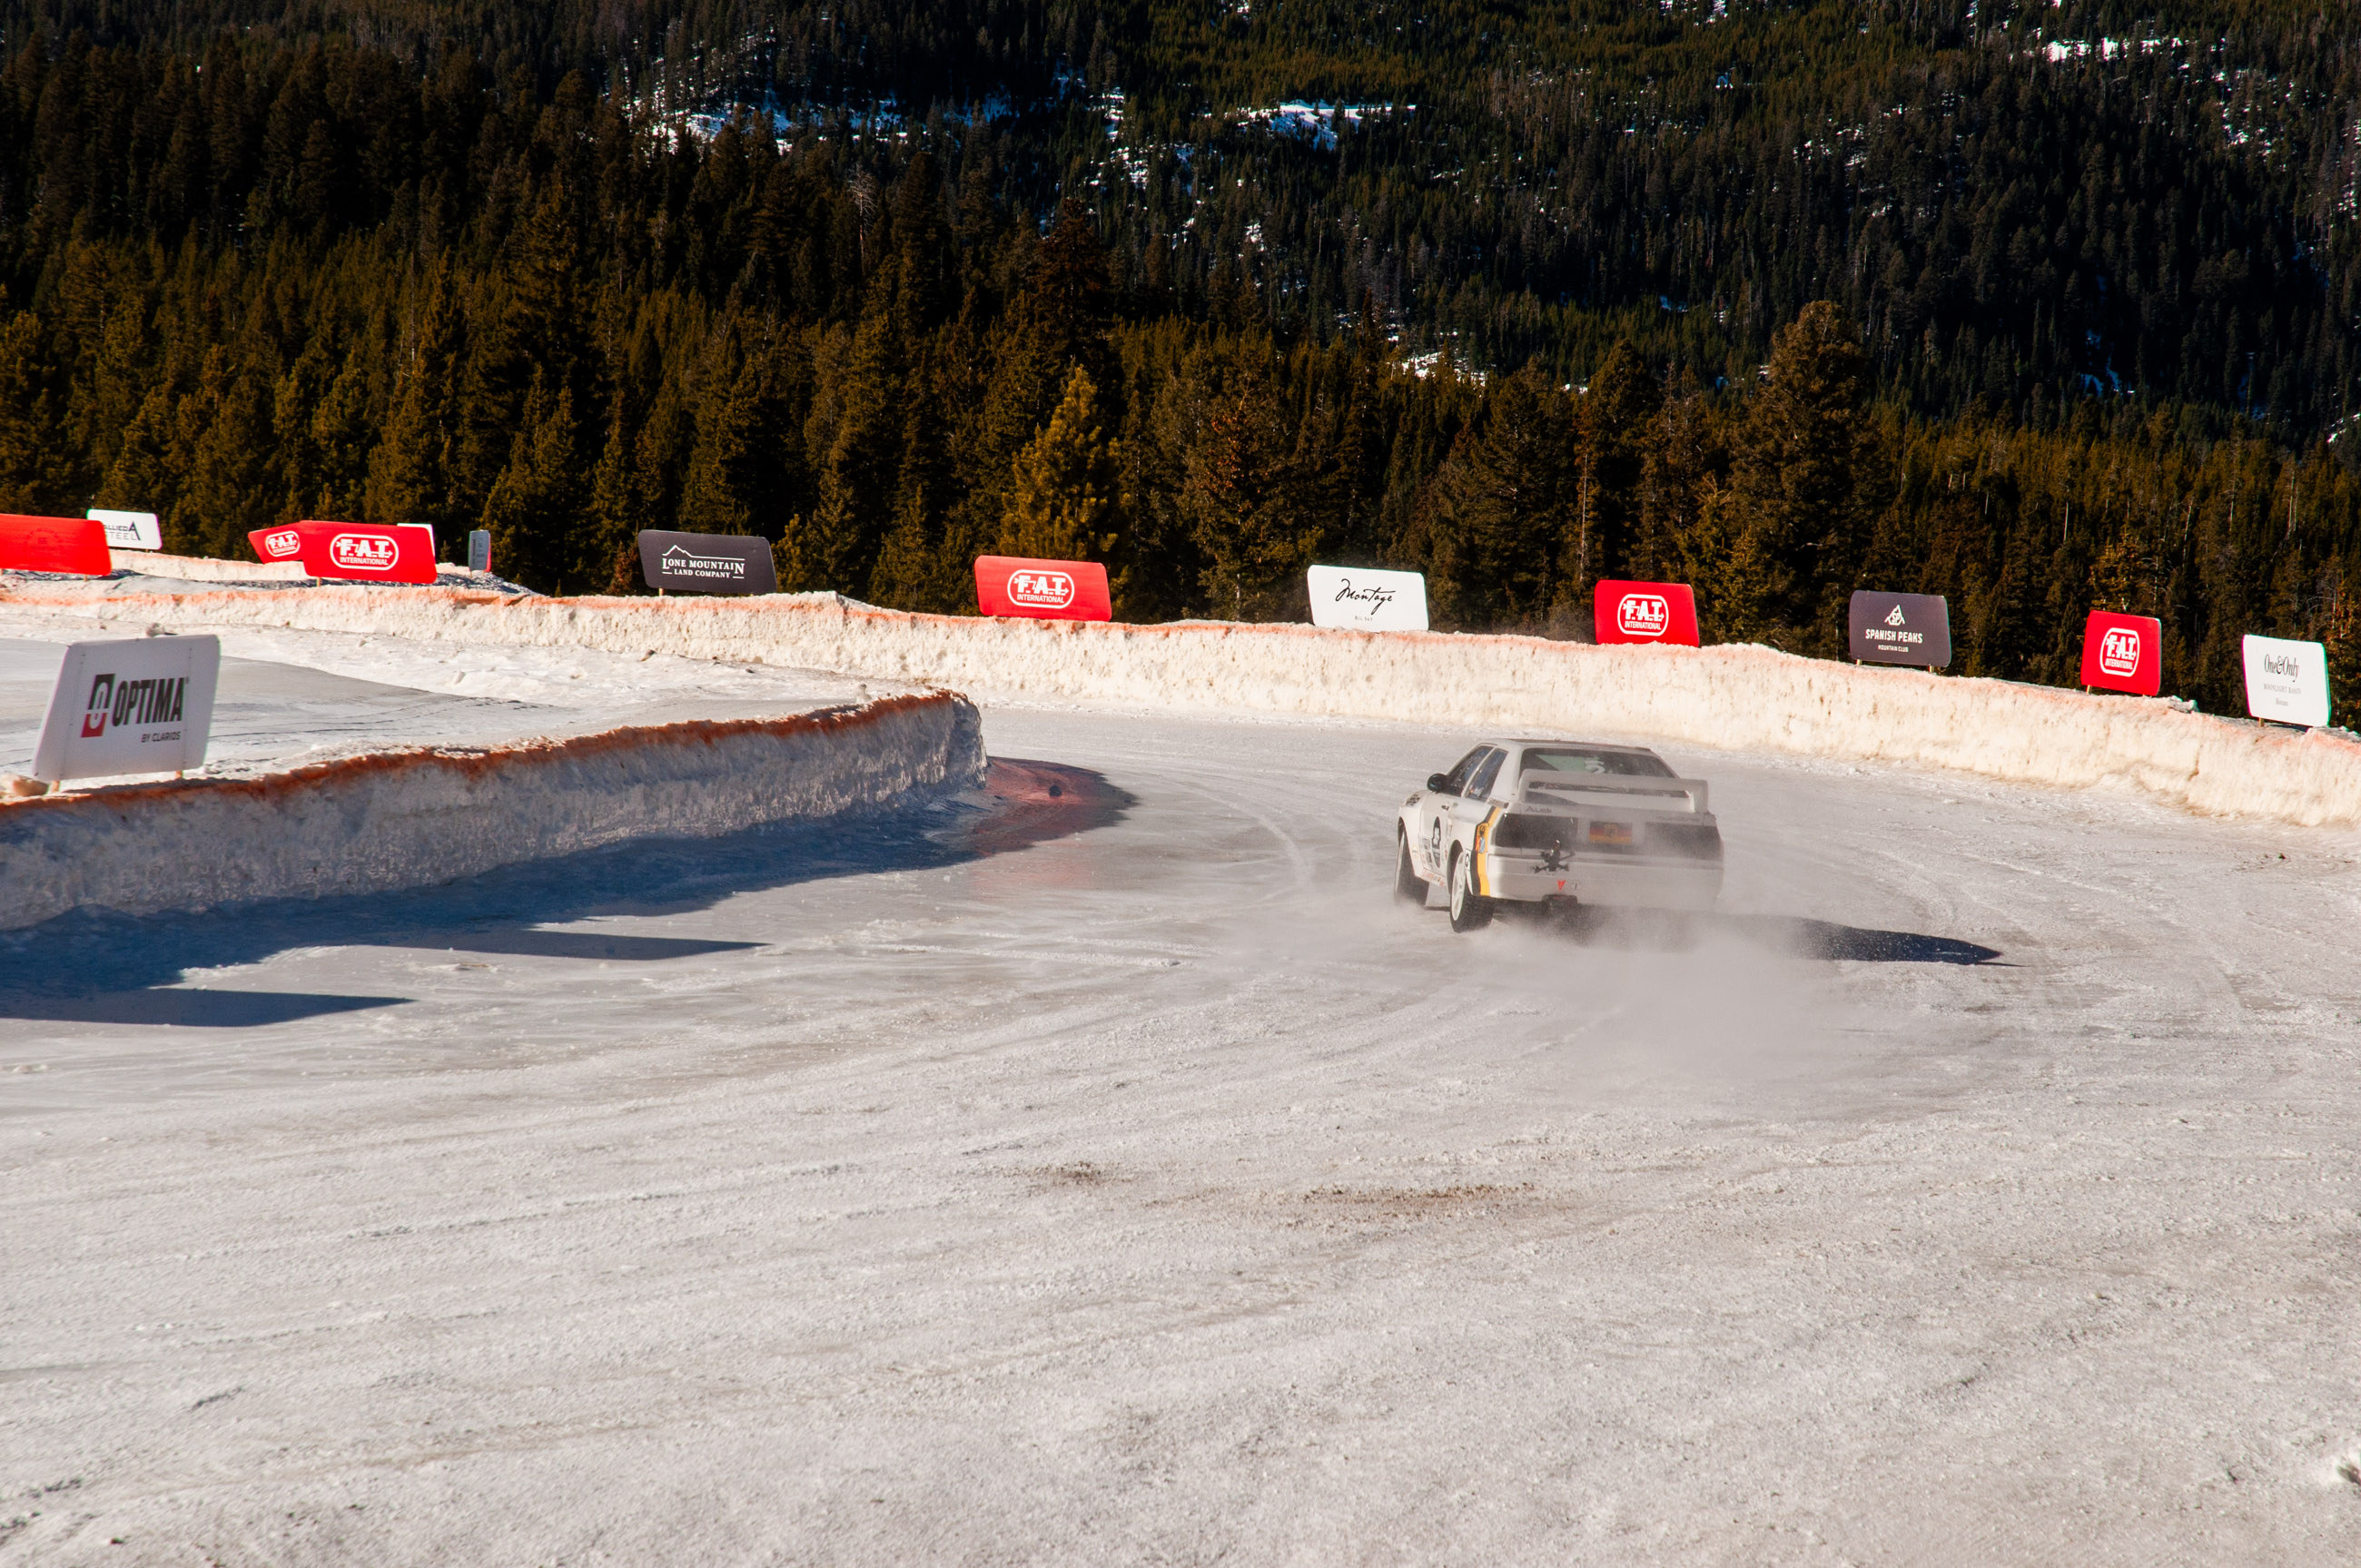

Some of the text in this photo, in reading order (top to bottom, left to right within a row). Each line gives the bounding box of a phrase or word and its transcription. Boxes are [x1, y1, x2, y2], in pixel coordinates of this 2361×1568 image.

[106, 530, 137, 541] TEEL
[340, 556, 389, 567] INTERNATIONAL
[662, 557, 745, 574] LONE MOUNTAIN
[674, 568, 731, 578] LAND COMPANY
[1017, 594, 1065, 604] INTERNATIONAL
[1335, 577, 1397, 616] Montage
[1625, 621, 1662, 630] INTERNATIONAL
[1865, 628, 1923, 644] SPANISH PEAKS
[1877, 644, 1898, 652] MOUNTAIN
[2264, 654, 2300, 683] One&Only
[112, 677, 184, 726] OPTIMA
[141, 731, 181, 743] BY CLARIOS
[1526, 805, 1552, 814] Audi
